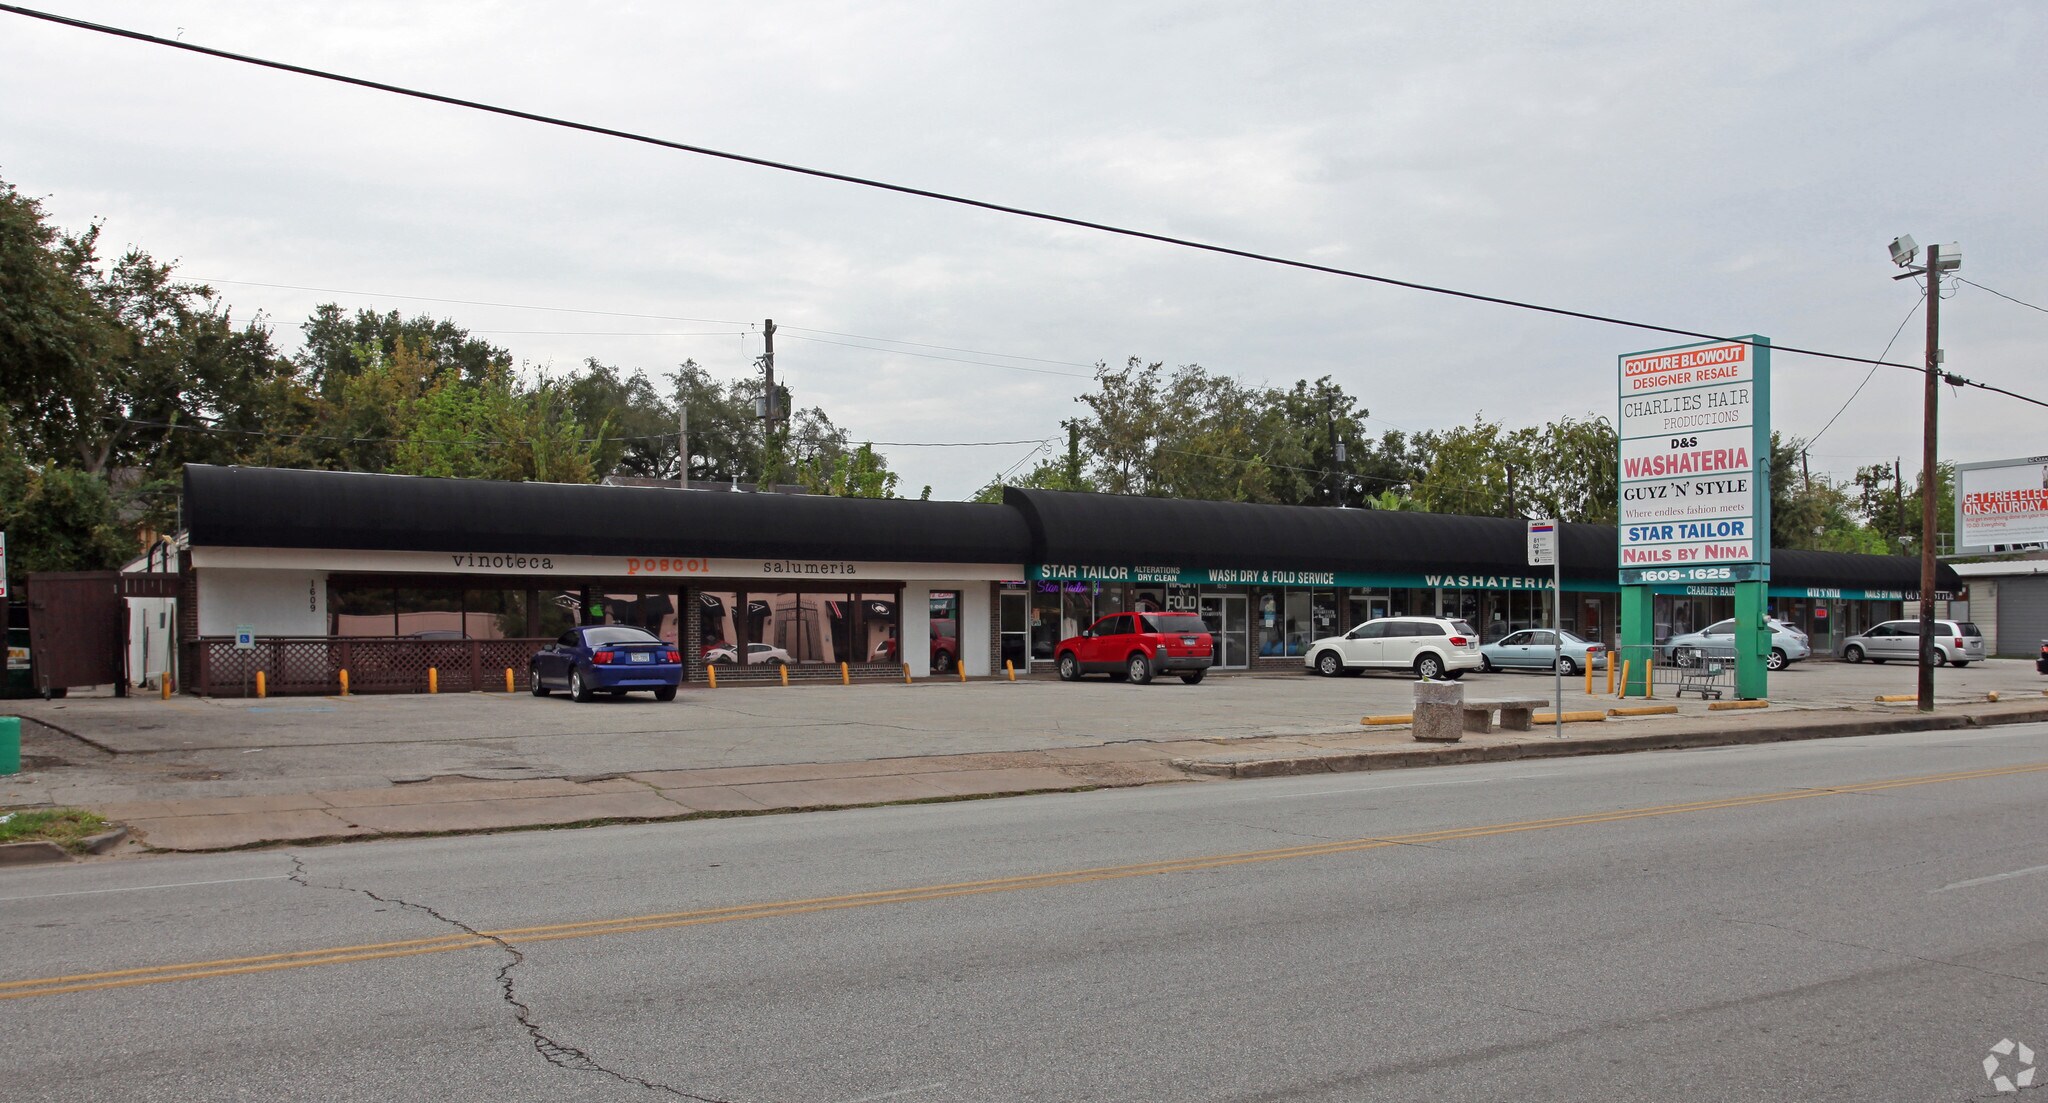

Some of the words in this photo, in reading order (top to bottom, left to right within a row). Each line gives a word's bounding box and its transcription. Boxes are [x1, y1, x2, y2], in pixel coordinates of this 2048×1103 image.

[1626, 355, 1679, 375] COUTURE
[1681, 347, 1742, 367] BLOWOUT
[1633, 372, 1691, 389] DESIGNER
[1696, 366, 1738, 381] RESALE
[1624, 394, 1702, 418] CHARLIES
[1708, 389, 1750, 408] HAIR
[1664, 410, 1739, 430] PRODUCTIONS
[1671, 437, 1698, 449] D&S
[1624, 447, 1749, 478] WASHATERIA
[1624, 485, 1667, 501] GUYZ
[1695, 479, 1747, 496] STYLE
[1964, 492, 1985, 504] GET
[1988, 490, 2017, 502] FREE
[2020, 488, 2048, 500] ELEC
[1626, 508, 1652, 518] Where
[1655, 506, 1684, 517] endless
[1687, 504, 1717, 515] fashion
[1720, 503, 1745, 513] meets
[1964, 503, 1981, 515] ON
[1628, 525, 1673, 541] STAR
[1679, 521, 1744, 539] TAILOR
[1623, 548, 1672, 563] NAILS
[1678, 548, 1698, 560] BY
[1705, 544, 1749, 559] NINA
[452, 553, 554, 570] vinoteca
[626, 557, 709, 575] poscol
[763, 560, 856, 575] salumeria
[1041, 565, 1077, 578] STAR
[1081, 565, 1128, 580] TAILOR
[1134, 566, 1180, 574] ALTERATIONS
[1137, 573, 1153, 581] DRY
[1154, 574, 1177, 582] CLEAN
[1209, 569, 1237, 582] WASH
[1240, 569, 1259, 583] DRY
[1262, 571, 1269, 583] &
[1272, 571, 1295, 584] FOLD
[1298, 572, 1334, 584] SERVICE
[1425, 575, 1556, 589] WASHATERIA
[1168, 595, 1197, 609] FOLD
[1865, 590, 1880, 599] NAILS
[1882, 590, 1888, 599] BY
[1890, 590, 1902, 599] NINA
